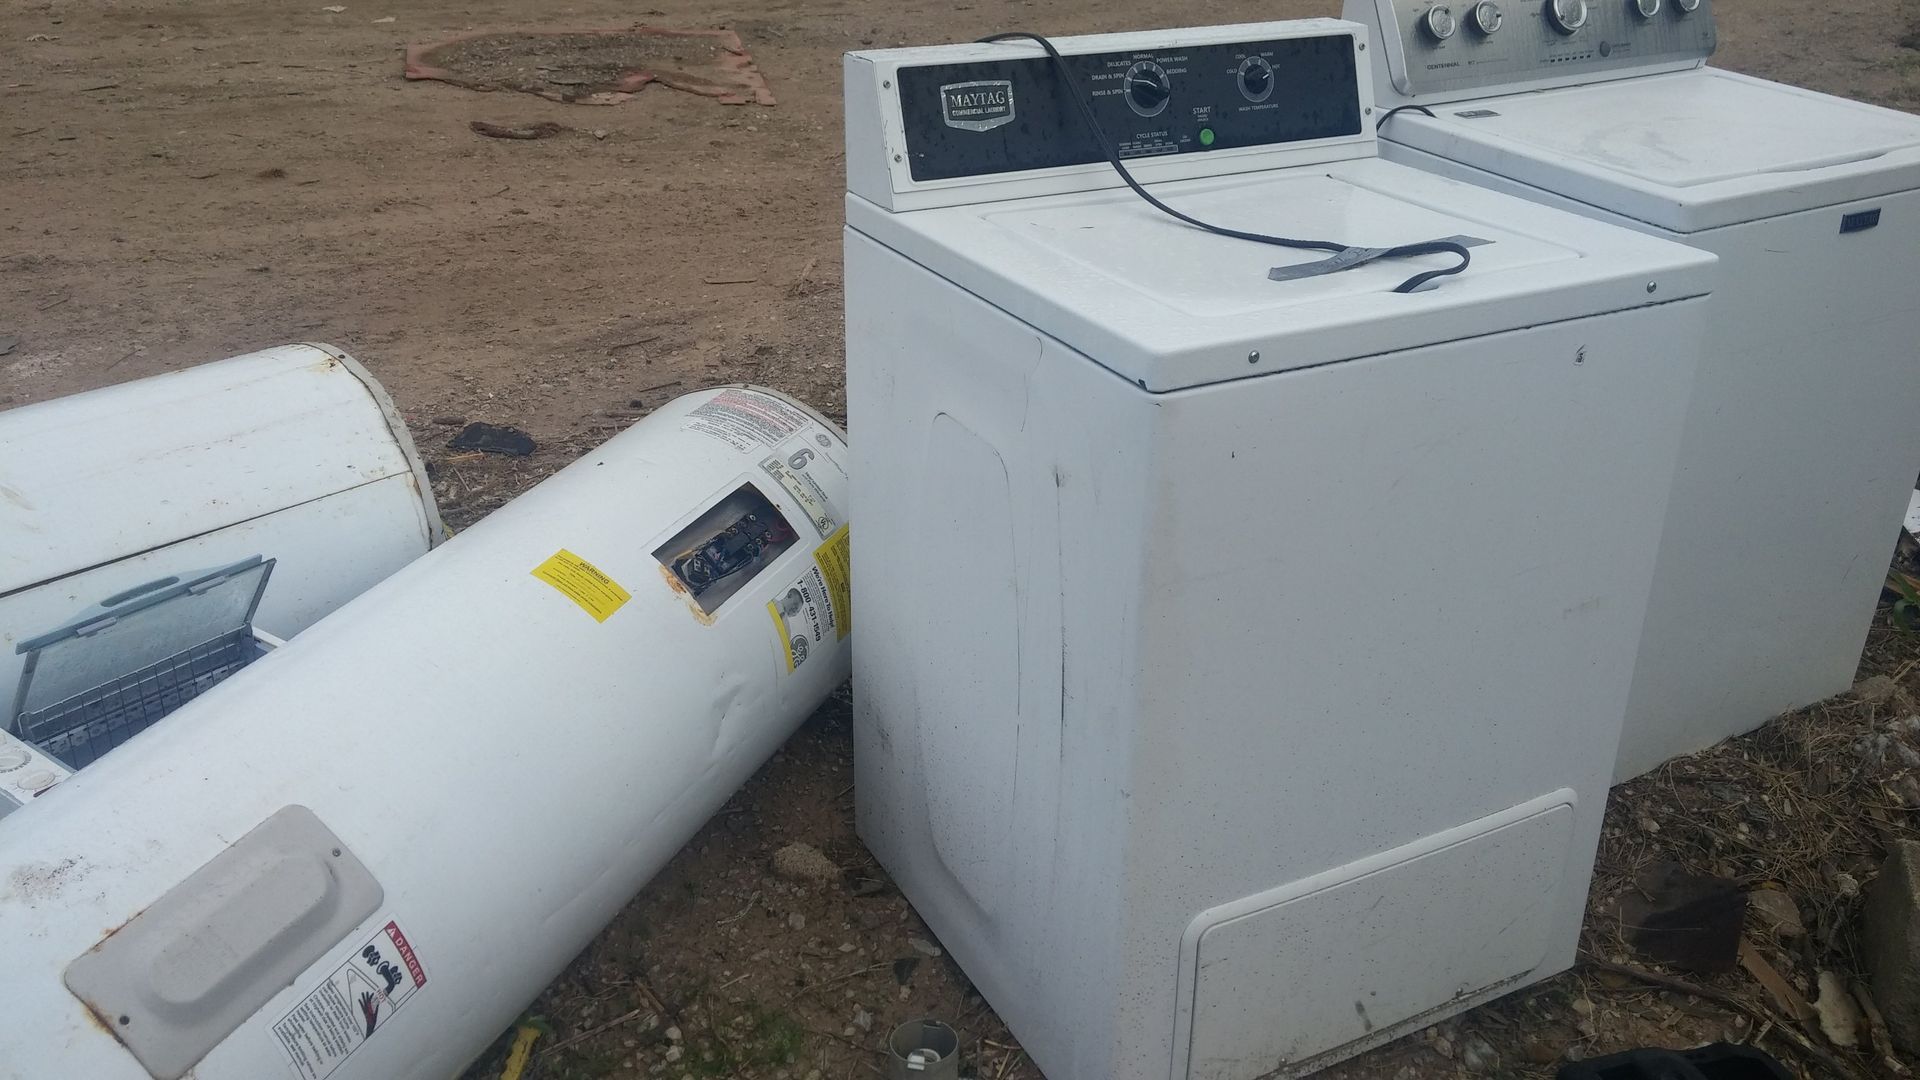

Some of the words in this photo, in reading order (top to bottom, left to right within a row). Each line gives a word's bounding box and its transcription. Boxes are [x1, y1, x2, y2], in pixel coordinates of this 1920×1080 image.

[950, 91, 1005, 107] MAYTAG
[1192, 106, 1211, 114] START
[952, 108, 984, 116] COMMERCIAL
[788, 448, 815, 470] 6
[580, 562, 610, 584] WARNING
[812, 566, 823, 586] We're
[820, 585, 829, 602] Here
[825, 601, 832, 609] To
[797, 580, 821, 642] 1-800-431-1549
[395, 937, 423, 983] DANGER
